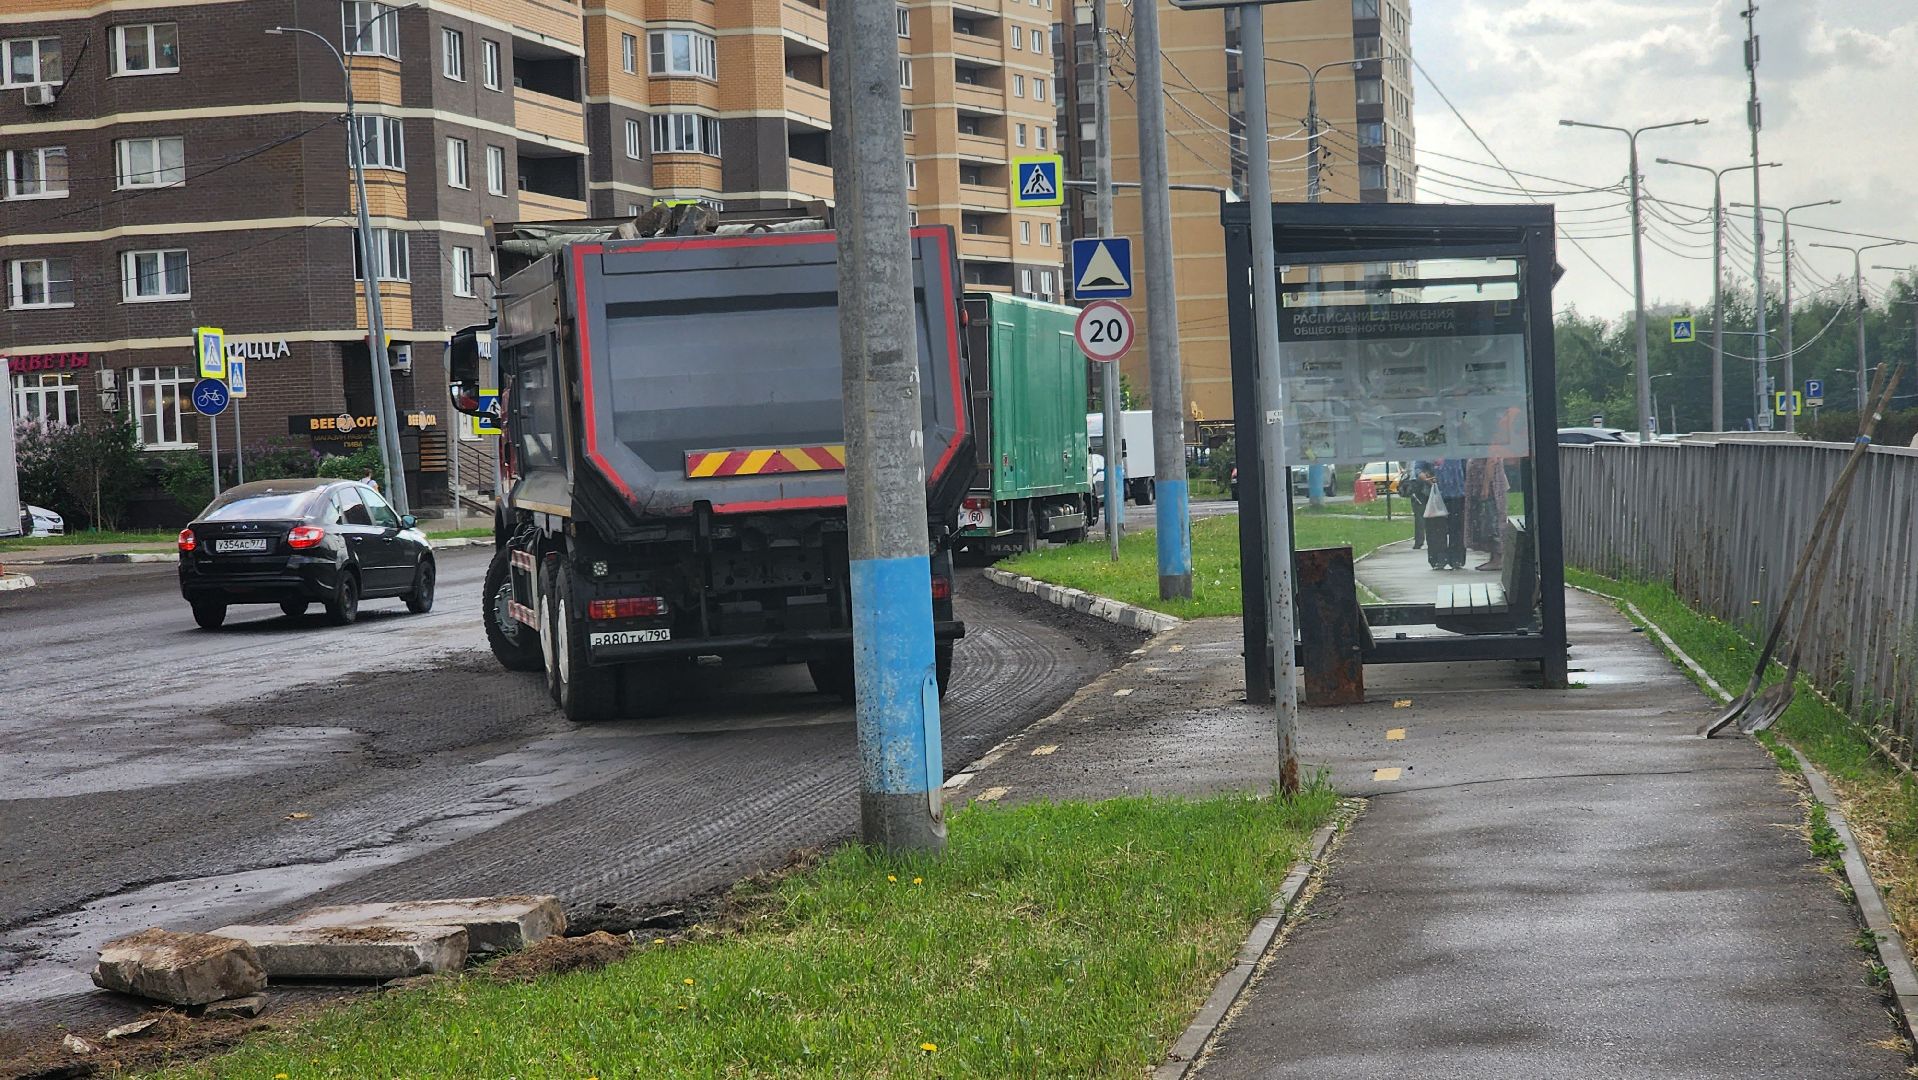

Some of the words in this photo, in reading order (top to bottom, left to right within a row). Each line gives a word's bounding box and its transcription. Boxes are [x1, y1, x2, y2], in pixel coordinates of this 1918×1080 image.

[1293, 312, 1378, 325] РАСПИСАНИЕ
[1381, 309, 1455, 321] ДВИЖЕНИЯ
[1089, 319, 1122, 343] 20
[1293, 324, 1384, 336] ОБЩЕСТВЕННОГО
[1389, 321, 1455, 332] ТРАНСПОРТА
[1810, 382, 1819, 395] P
[971, 513, 981, 522] 60
[991, 544, 1022, 552] MAN
